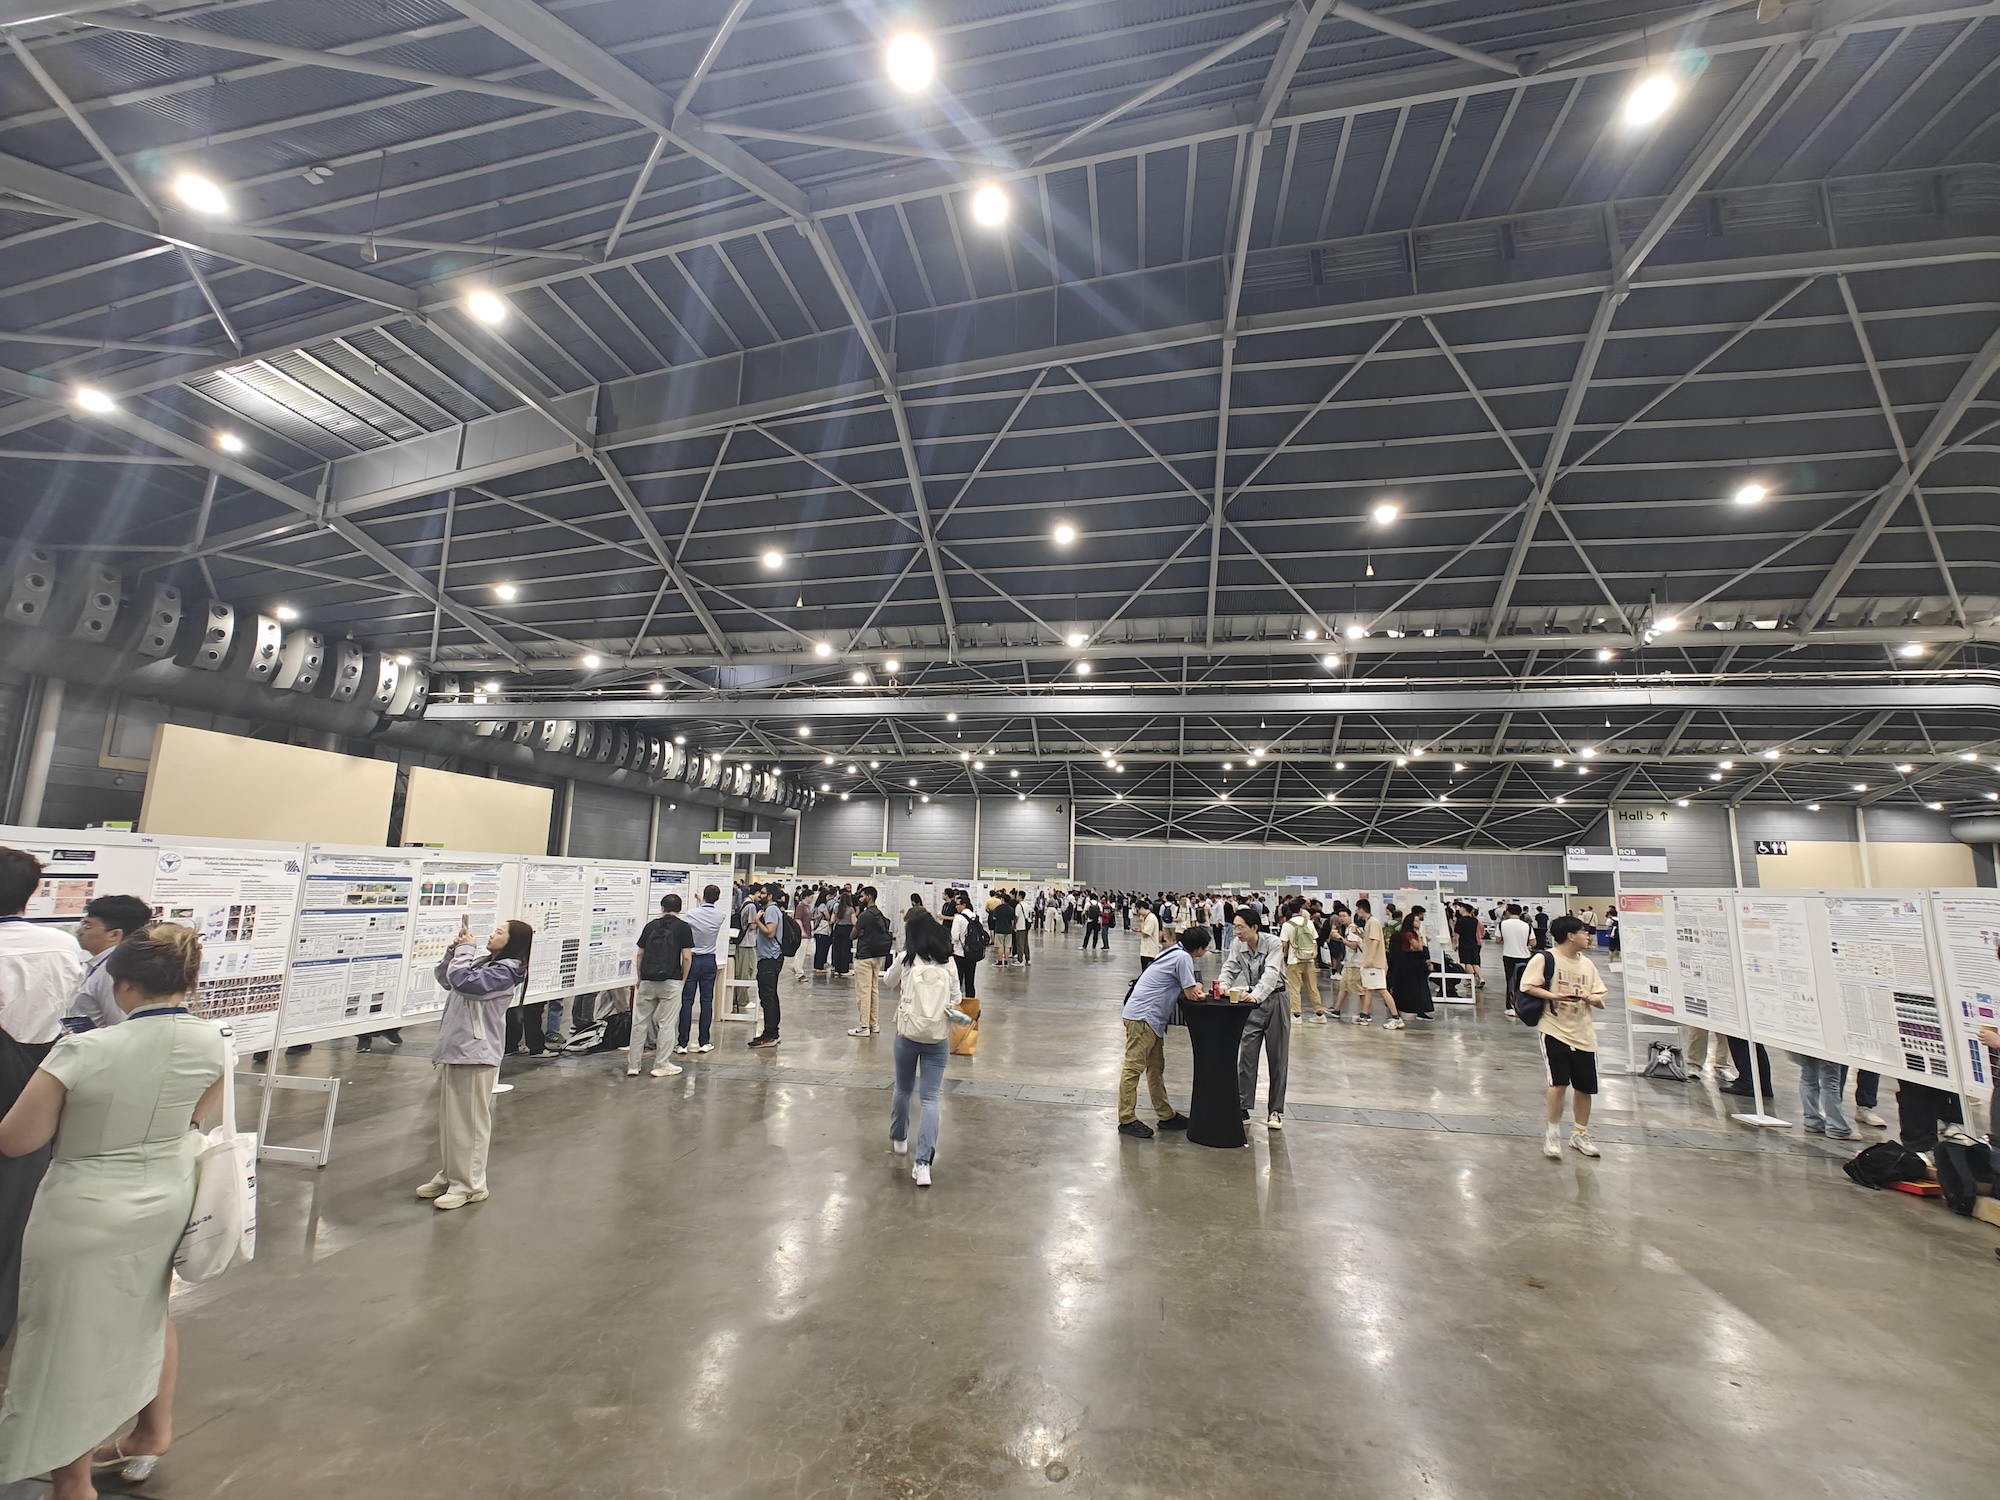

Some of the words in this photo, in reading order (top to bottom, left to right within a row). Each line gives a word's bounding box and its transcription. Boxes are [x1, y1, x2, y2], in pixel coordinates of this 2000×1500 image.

[1055, 804, 1064, 814] 4
[1619, 810, 1643, 821] Hall
[1645, 812, 1654, 821] 5
[1618, 848, 1637, 856] ROB
